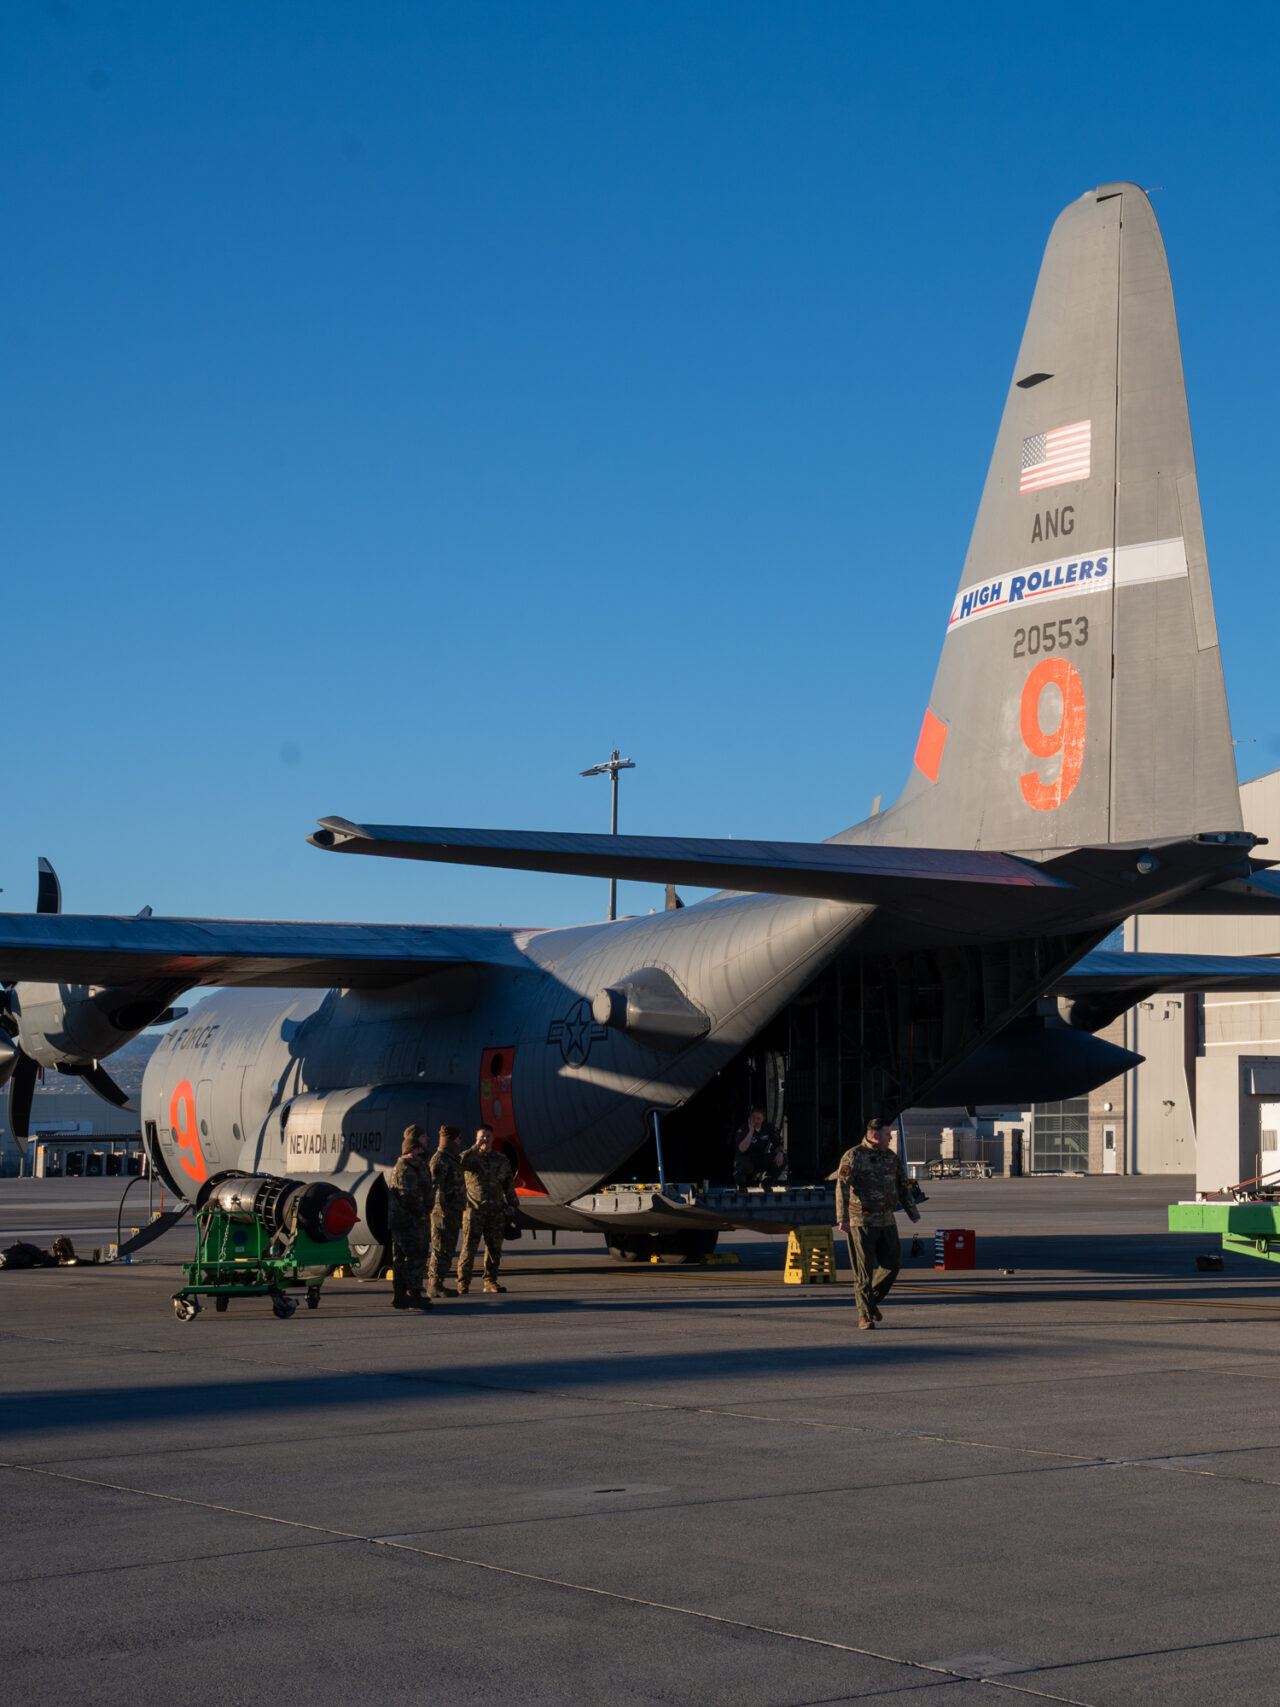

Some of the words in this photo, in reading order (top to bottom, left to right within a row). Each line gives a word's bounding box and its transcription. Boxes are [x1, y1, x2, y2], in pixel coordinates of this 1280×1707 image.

[1031, 506, 1075, 543] ANG
[960, 581, 1002, 619] HIGH
[1008, 557, 1109, 602] ROLLERS
[1013, 616, 1089, 658] 20553
[1020, 657, 1086, 811] 9
[171, 1024, 221, 1052] FORCE
[170, 1079, 207, 1183] 9
[289, 1134, 328, 1155] NEVADA
[331, 1133, 346, 1154] AIR
[349, 1131, 383, 1153] GUARD
